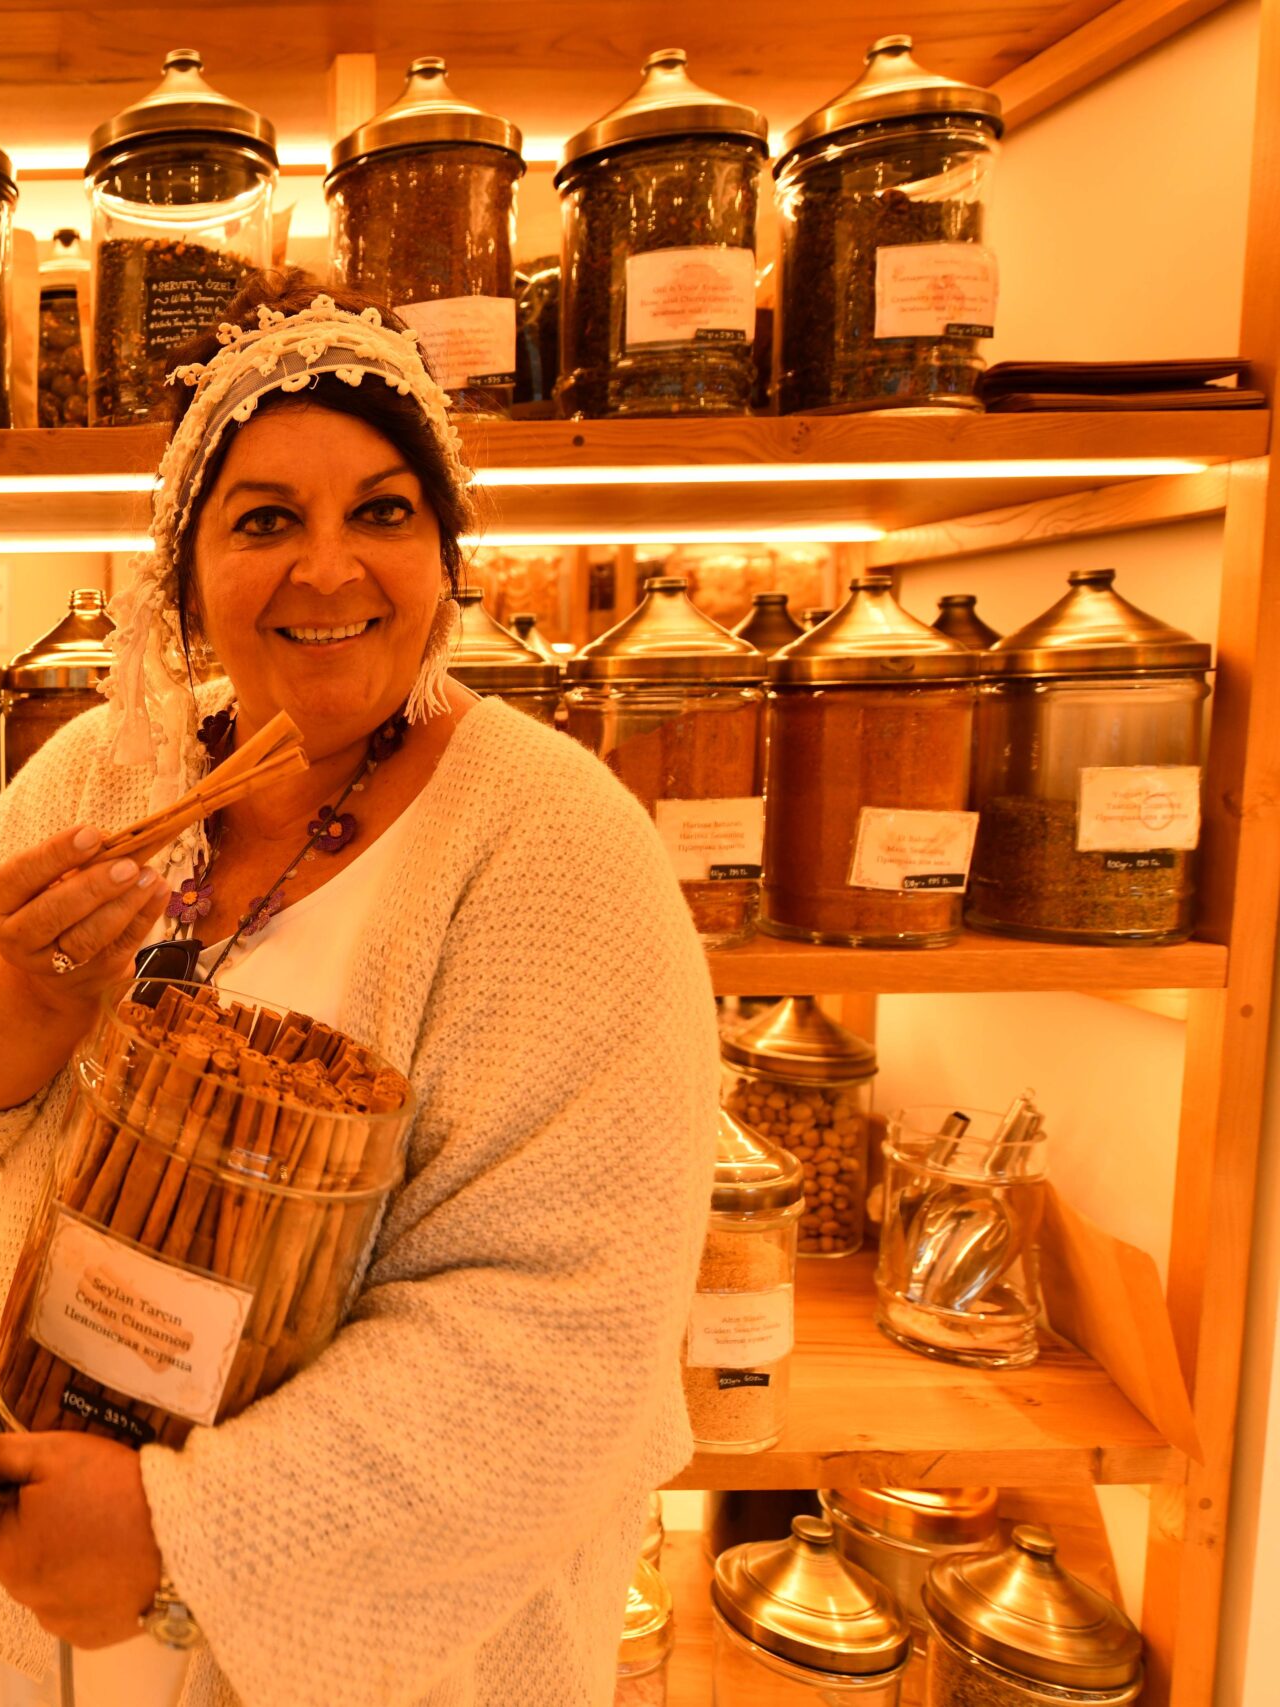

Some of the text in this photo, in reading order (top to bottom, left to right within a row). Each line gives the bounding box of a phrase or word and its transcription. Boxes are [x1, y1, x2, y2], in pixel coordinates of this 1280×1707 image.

[74, 1289, 192, 1353] Ceylan Cinnamon
[92, 1276, 183, 1328] Seylan Tarçın
[63, 1303, 194, 1374] Цейлонская корица
